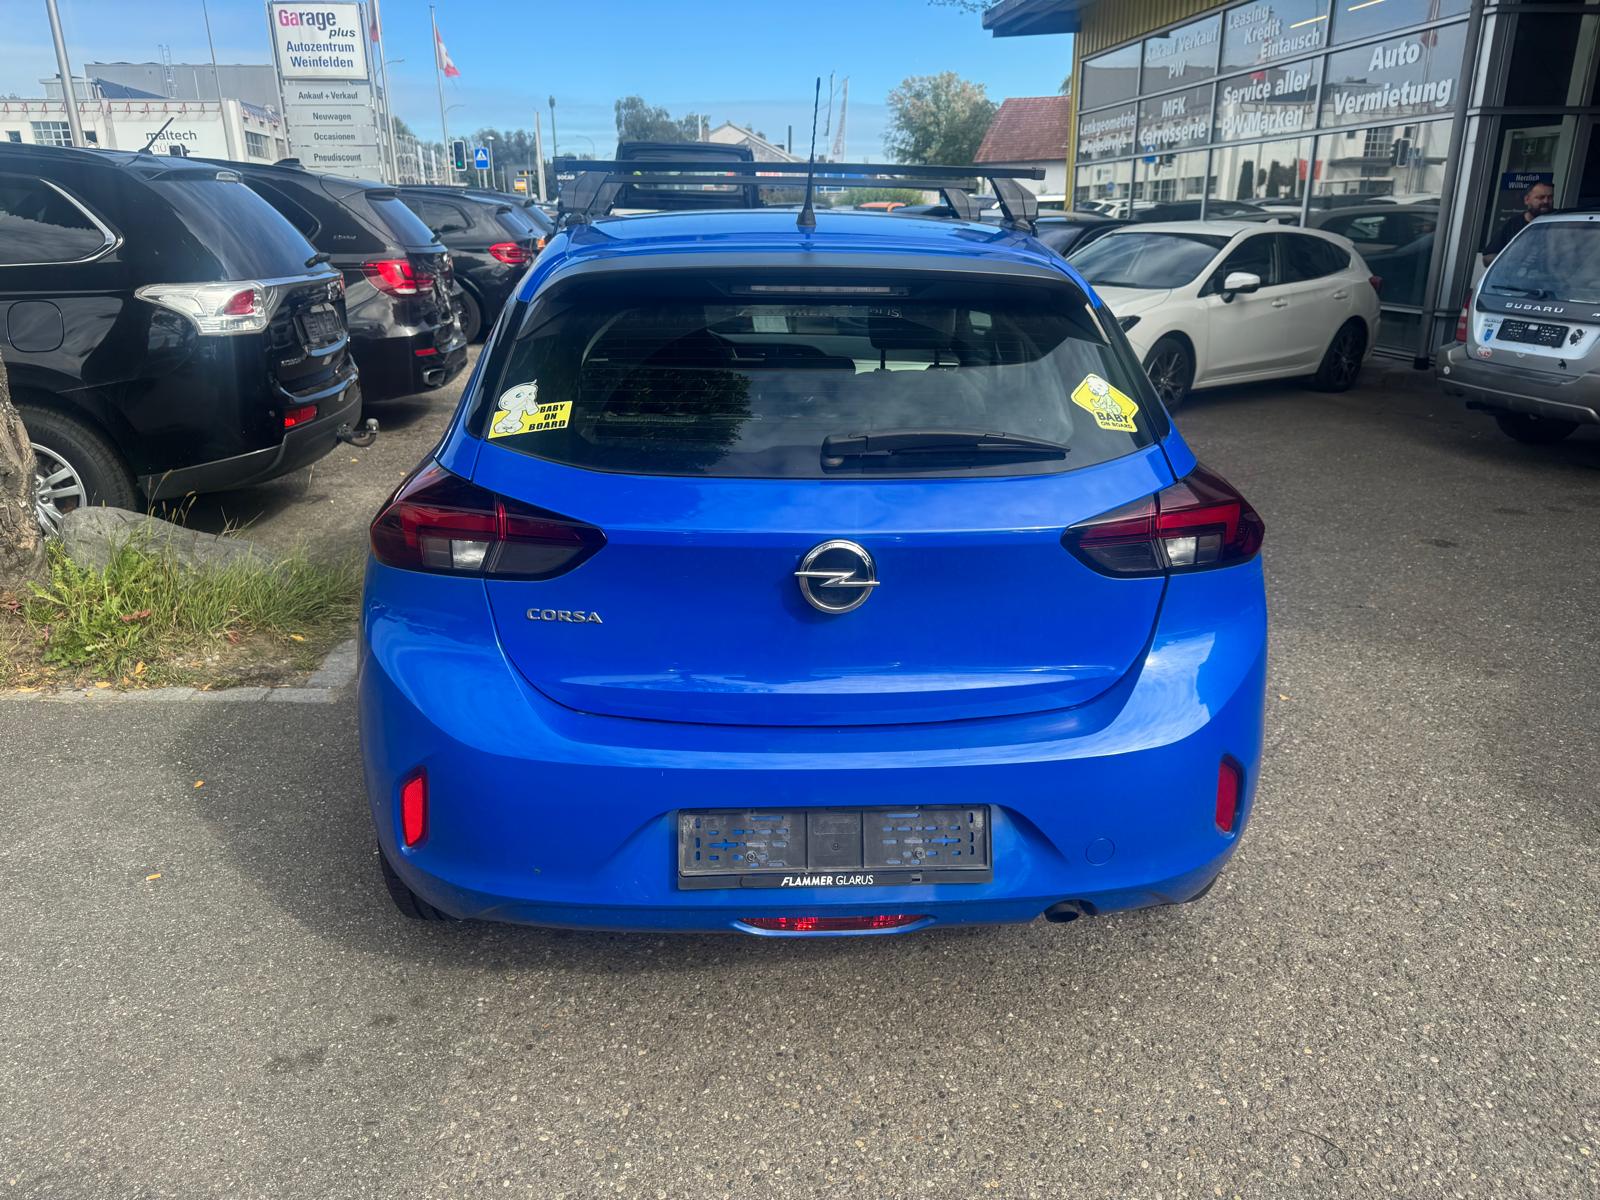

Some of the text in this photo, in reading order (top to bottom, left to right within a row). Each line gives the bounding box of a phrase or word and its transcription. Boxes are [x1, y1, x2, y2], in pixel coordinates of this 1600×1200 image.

[279, 9, 336, 31] Garage
[329, 28, 356, 39] plus
[1244, 17, 1282, 45] Kredit
[286, 41, 355, 53] Autozentrum
[1260, 27, 1320, 58] Eintausch
[290, 56, 354, 68] Weinfelden
[1368, 40, 1421, 72] Auto
[1168, 59, 1187, 80] PW
[1223, 70, 1311, 106] Service aller
[298, 91, 324, 100] Ankauf
[331, 91, 358, 100] Verkauf
[1334, 78, 1453, 115] Vermietung
[1161, 97, 1186, 118] MFK
[312, 112, 352, 122] Neuwagen
[146, 130, 197, 141] maltech
[314, 132, 356, 141] Occasionen
[1139, 120, 1206, 147] Carrosserie
[314, 153, 362, 162] Pneudiscount
[1515, 174, 1540, 182] Herzlich
[1505, 302, 1564, 314] SUBARU
[540, 403, 565, 414] BABY
[544, 413, 557, 421] ON
[1096, 411, 1129, 424] BABY
[528, 420, 566, 431] BOARD
[526, 608, 603, 624] CORSA
[781, 875, 874, 887] FLAMMER GLARUS
